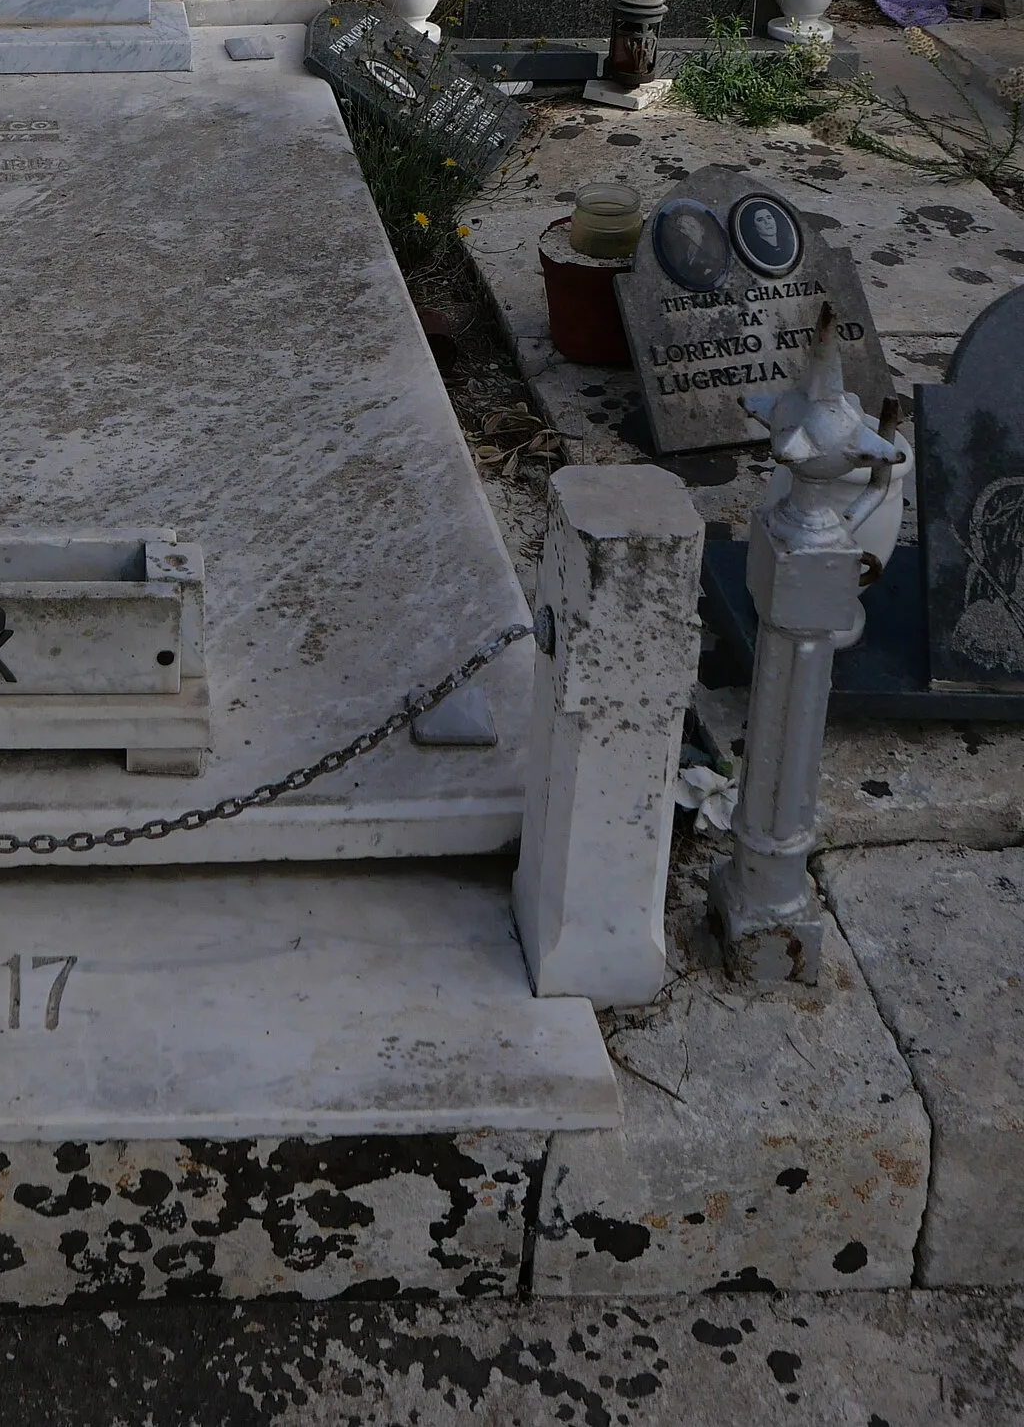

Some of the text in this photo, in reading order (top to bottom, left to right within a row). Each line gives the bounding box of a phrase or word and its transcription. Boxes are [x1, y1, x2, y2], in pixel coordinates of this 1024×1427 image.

[661, 279, 827, 313] TIFKIRA GHAZIZA
[649, 321, 865, 367] LORENZO ATTRD
[0, 953, 78, 1030] 17
